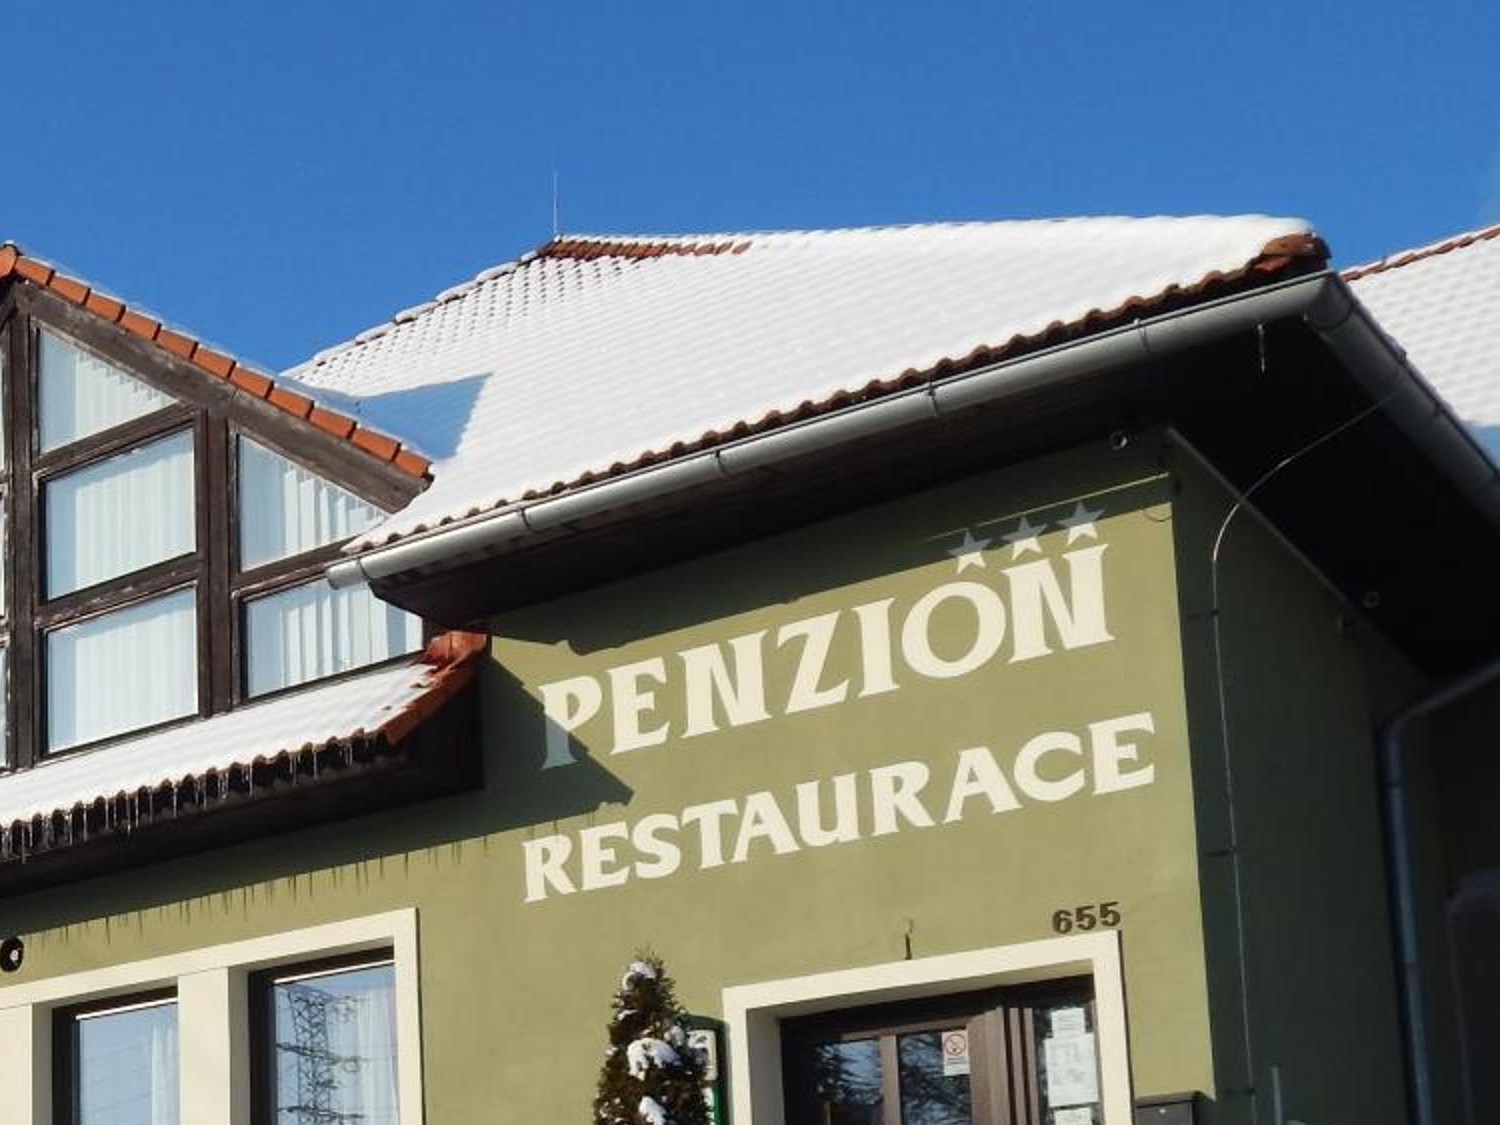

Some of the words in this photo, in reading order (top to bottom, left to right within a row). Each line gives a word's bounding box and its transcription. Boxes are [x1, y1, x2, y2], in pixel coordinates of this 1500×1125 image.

[538, 543, 1116, 771] PENZION
[521, 711, 1156, 902] RESTAURACE
[1052, 901, 1122, 935] 655
